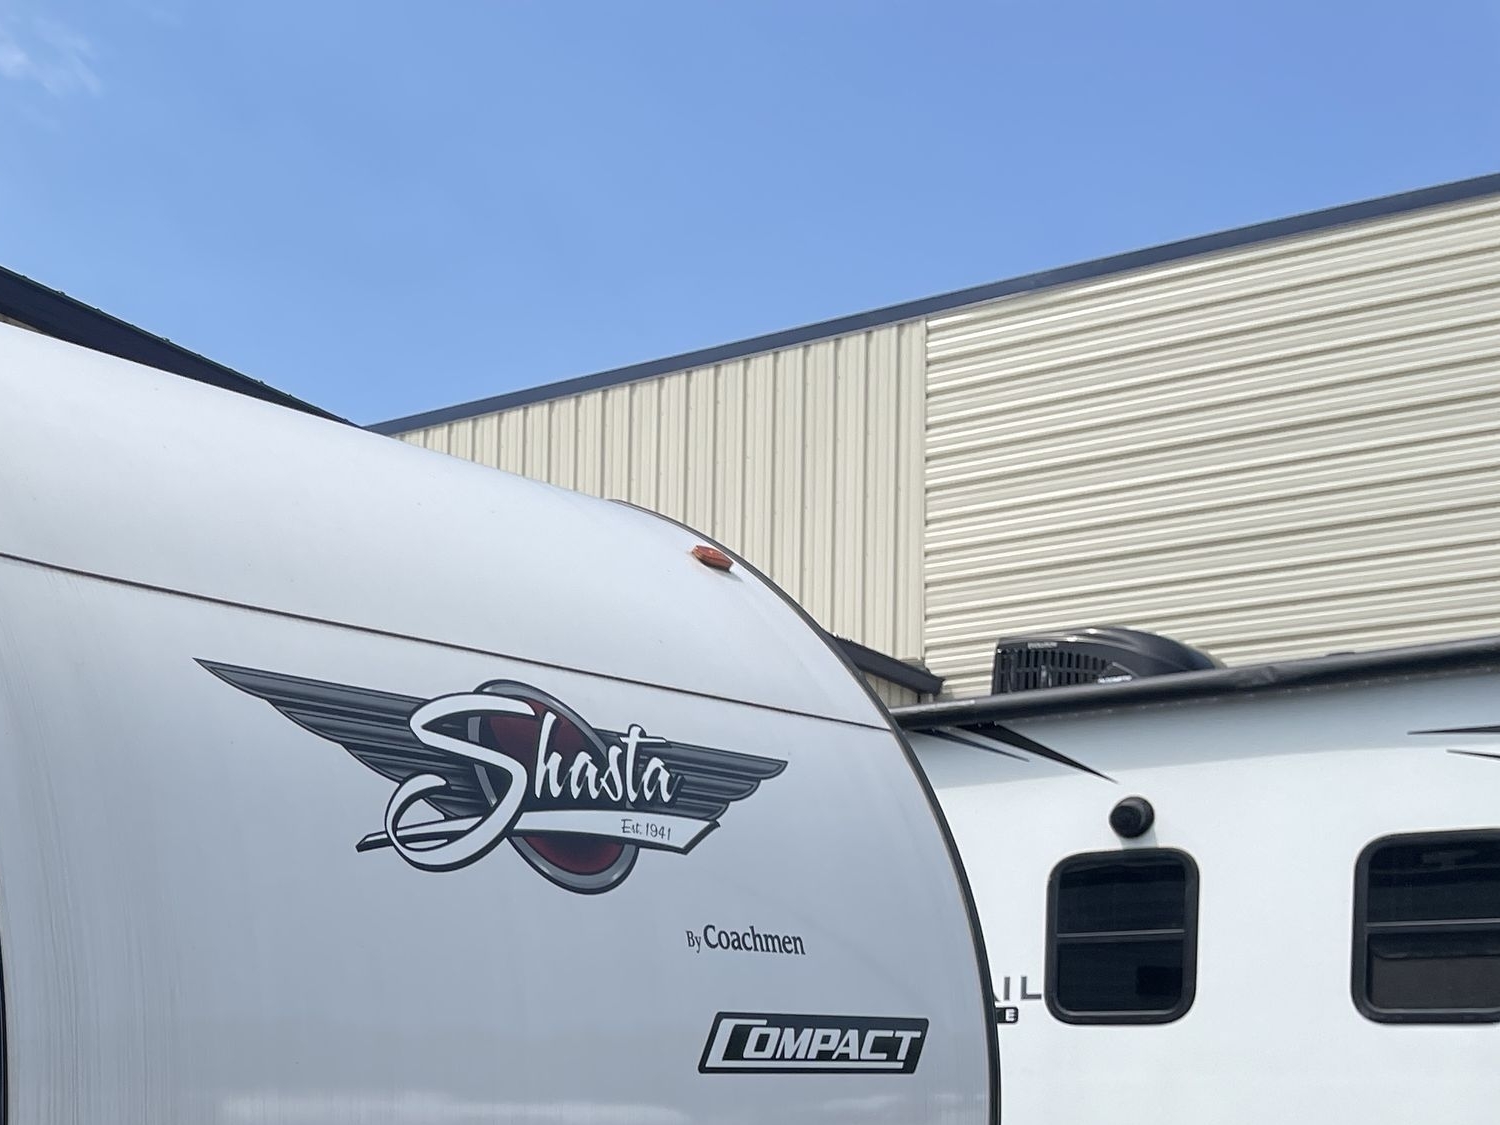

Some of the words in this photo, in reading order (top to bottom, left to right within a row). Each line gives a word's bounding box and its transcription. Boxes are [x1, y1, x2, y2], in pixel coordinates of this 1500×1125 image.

[386, 691, 678, 867] Shasta
[621, 819, 642, 835] Est.
[645, 822, 671, 841] 1941
[685, 930, 701, 954] By
[703, 924, 806, 955] Coachmen
[995, 976, 1042, 1001] IL
[705, 1018, 922, 1069] COMPACT
